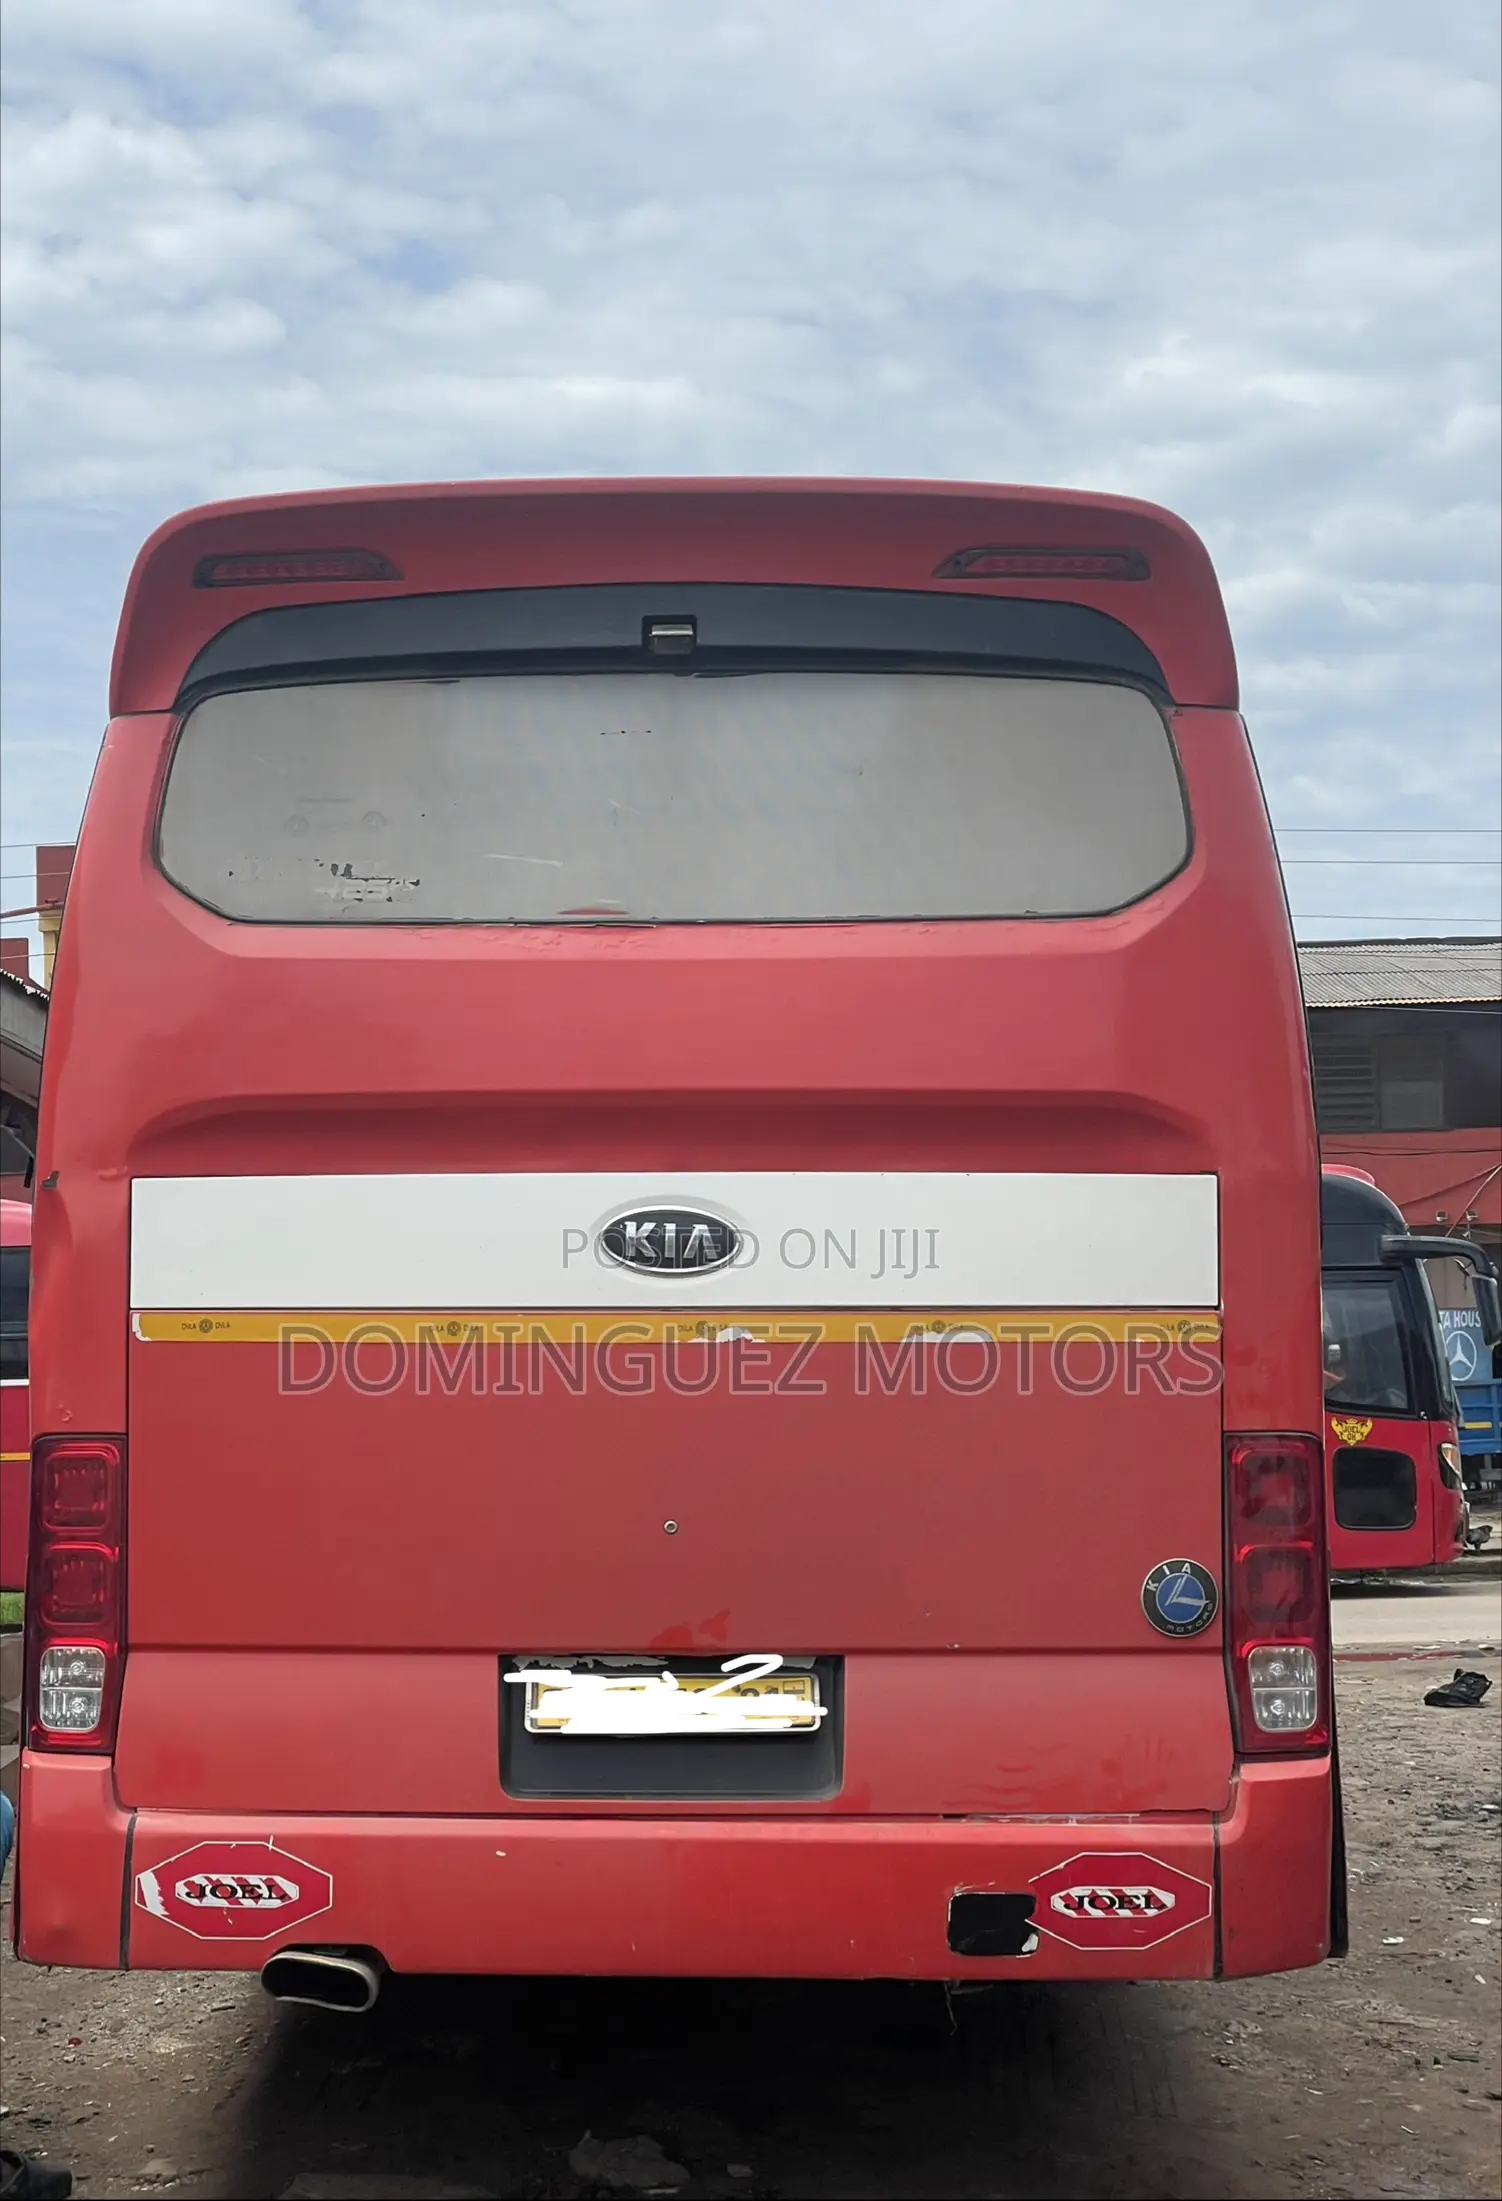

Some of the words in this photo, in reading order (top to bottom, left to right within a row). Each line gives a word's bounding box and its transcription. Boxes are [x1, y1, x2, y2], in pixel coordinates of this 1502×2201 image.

[622, 1220, 719, 1260] KIA
[1146, 1562, 1191, 1592] KIA
[184, 1883, 291, 1900] JOEL
[1063, 1894, 1168, 1911] JOEL
